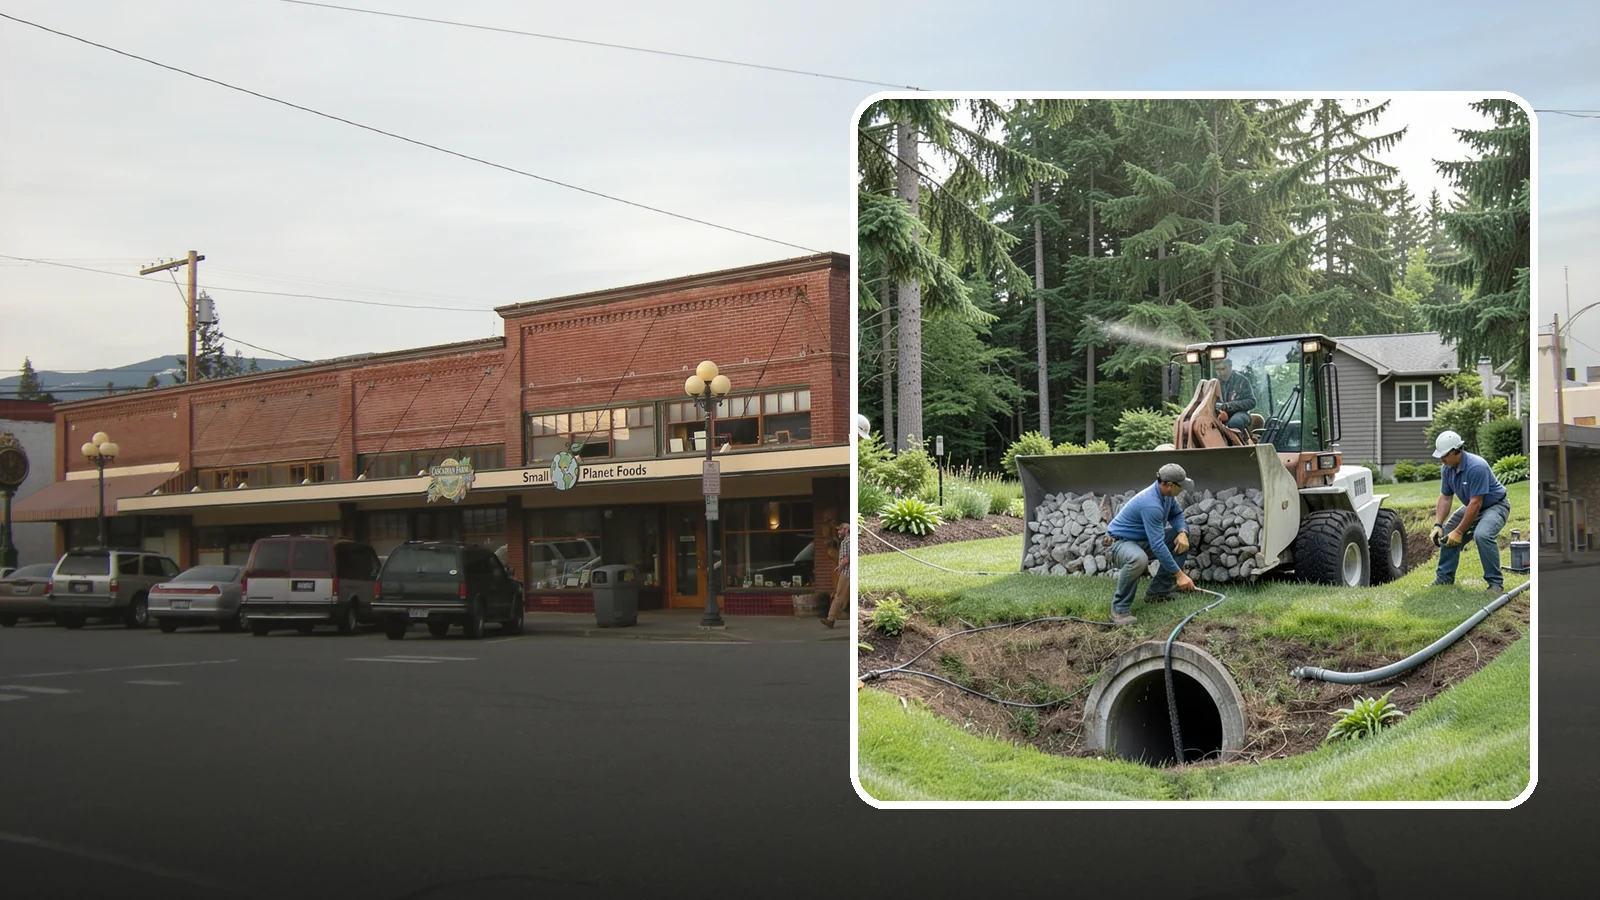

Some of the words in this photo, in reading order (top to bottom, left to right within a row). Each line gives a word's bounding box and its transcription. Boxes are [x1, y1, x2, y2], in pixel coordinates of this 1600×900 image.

[431, 467, 456, 476] CASCADIAN
[523, 471, 549, 483] Small
[583, 467, 614, 479] Planet
[617, 464, 647, 477] Foods
